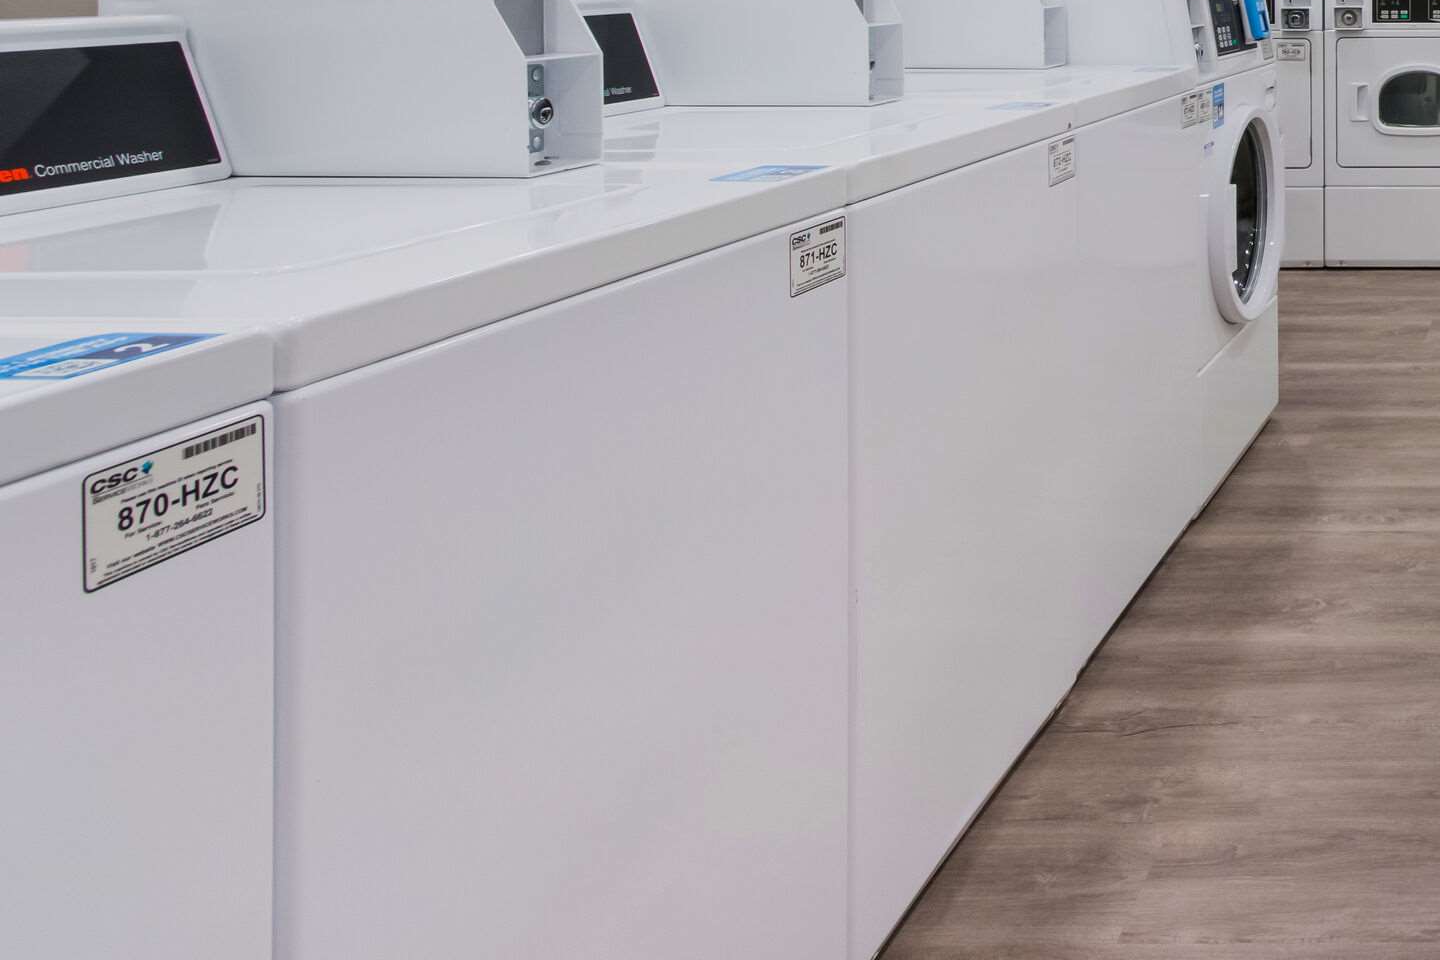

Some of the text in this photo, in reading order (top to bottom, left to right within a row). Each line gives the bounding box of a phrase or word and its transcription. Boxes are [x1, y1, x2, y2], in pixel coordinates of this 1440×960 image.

[34, 154, 115, 177] Commercial
[117, 150, 164, 166] Washer
[800, 243, 838, 268] 871-HZC
[90, 467, 138, 495] CSC
[118, 465, 239, 531] 870-HZC
